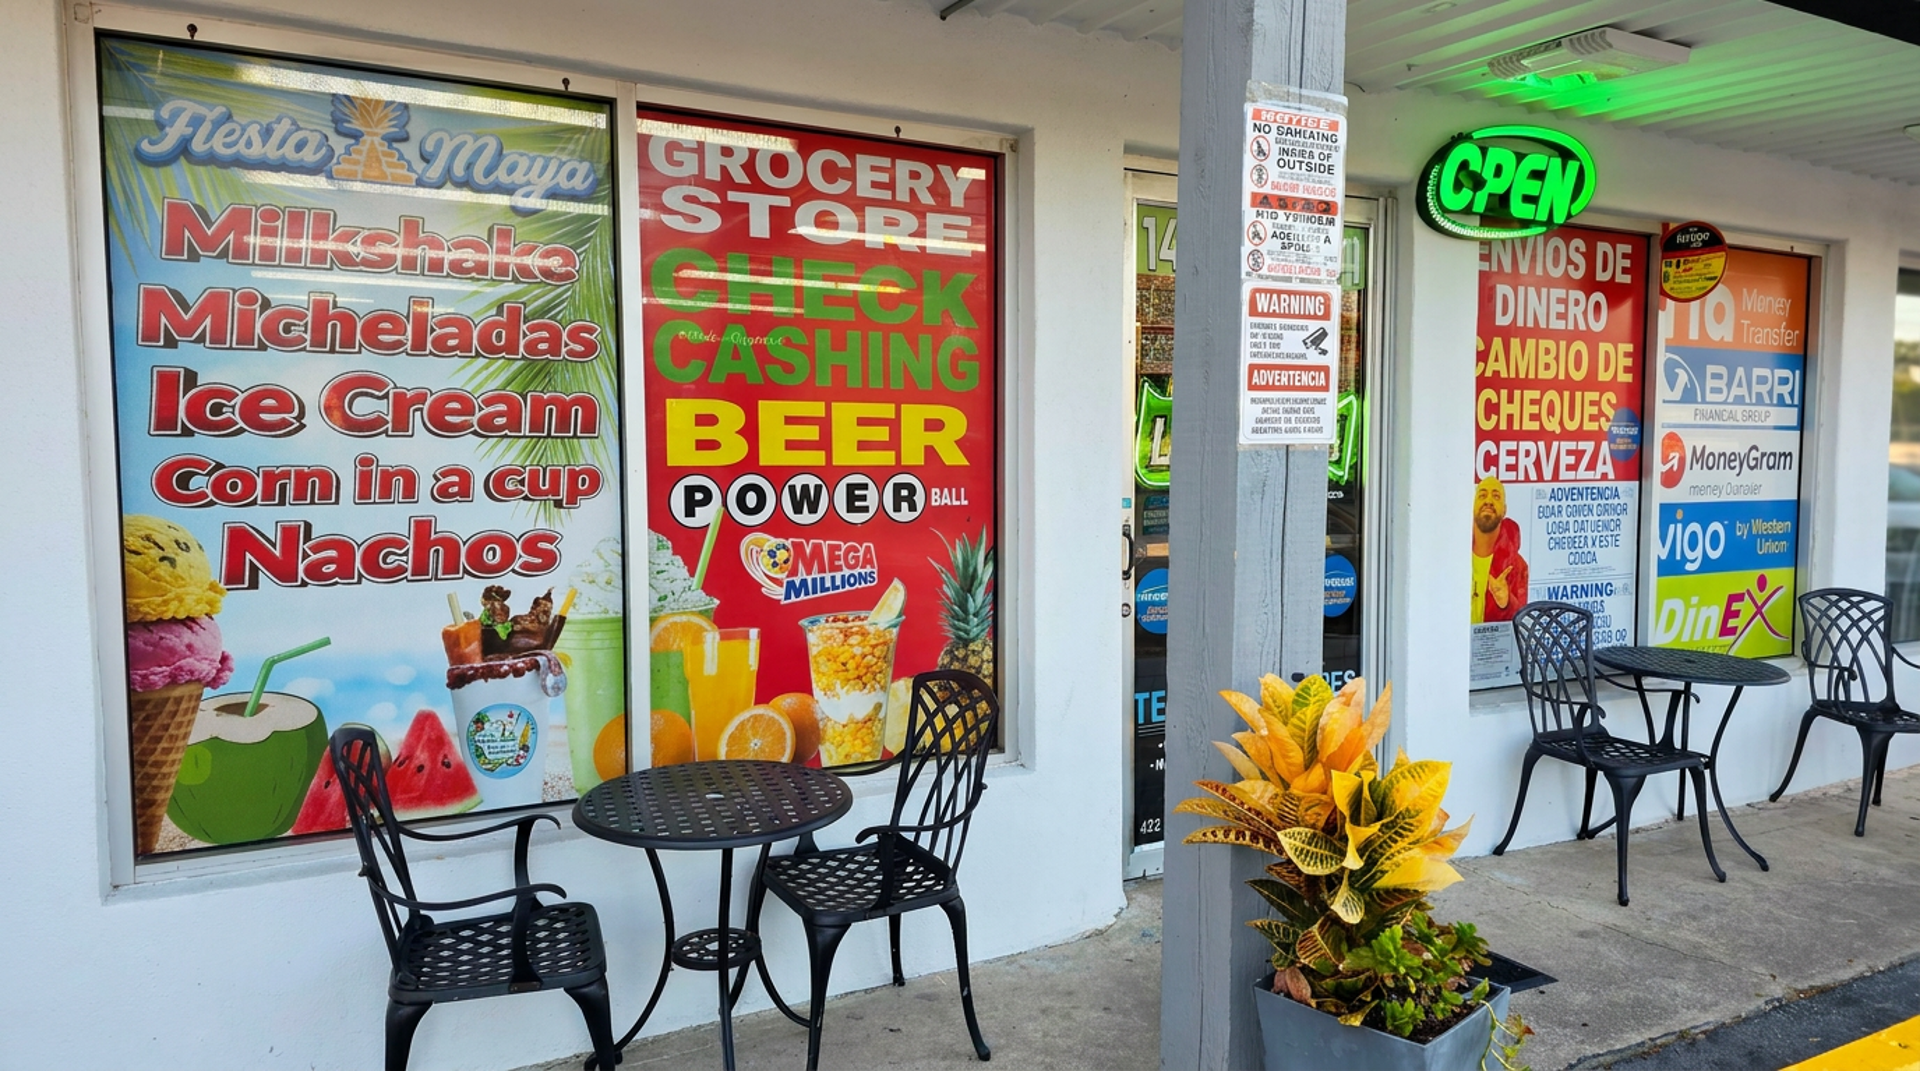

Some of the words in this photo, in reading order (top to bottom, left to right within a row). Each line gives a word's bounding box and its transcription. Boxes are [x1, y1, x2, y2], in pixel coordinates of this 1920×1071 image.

[1253, 122, 1271, 134] NO
[137, 100, 332, 167] Fiesta
[421, 130, 595, 212] Maya
[648, 135, 975, 208] GROCERY
[1277, 157, 1335, 176] OUTSIDE
[161, 197, 580, 285] Milkshake
[660, 184, 972, 257] STORE
[1478, 234, 1587, 280] ENVIOS
[1595, 241, 1632, 284] DE
[651, 247, 979, 329] CHECK
[1255, 292, 1325, 316] WARNING
[1495, 283, 1608, 332] DINERO
[136, 283, 602, 360] Micheladas
[1741, 319, 1800, 347] Transfer
[652, 319, 980, 392] CASHING
[1252, 369, 1326, 387] ADVERTENCIA
[1597, 341, 1634, 383] DE
[149, 364, 305, 438] Ice
[319, 370, 600, 439] Cream
[1706, 364, 1800, 406] BARRI
[666, 398, 970, 467] BEER
[1478, 387, 1618, 435] CHEQUES
[151, 453, 339, 508] Corn
[353, 453, 421, 504] in
[433, 464, 476, 503] a
[485, 464, 604, 509] cup
[1476, 439, 1615, 482] CERVEZA
[1689, 444, 1793, 477] MoneyGram
[681, 480, 920, 521] POWER
[931, 487, 969, 507] BALL
[219, 514, 562, 589] Nachos
[1658, 508, 1727, 572] vigo
[1736, 520, 1750, 539] by
[787, 537, 878, 578] MEGA
[783, 570, 877, 602] MILLIONS
[1547, 581, 1614, 601] WARNING
[1655, 585, 1790, 656] DinEX
